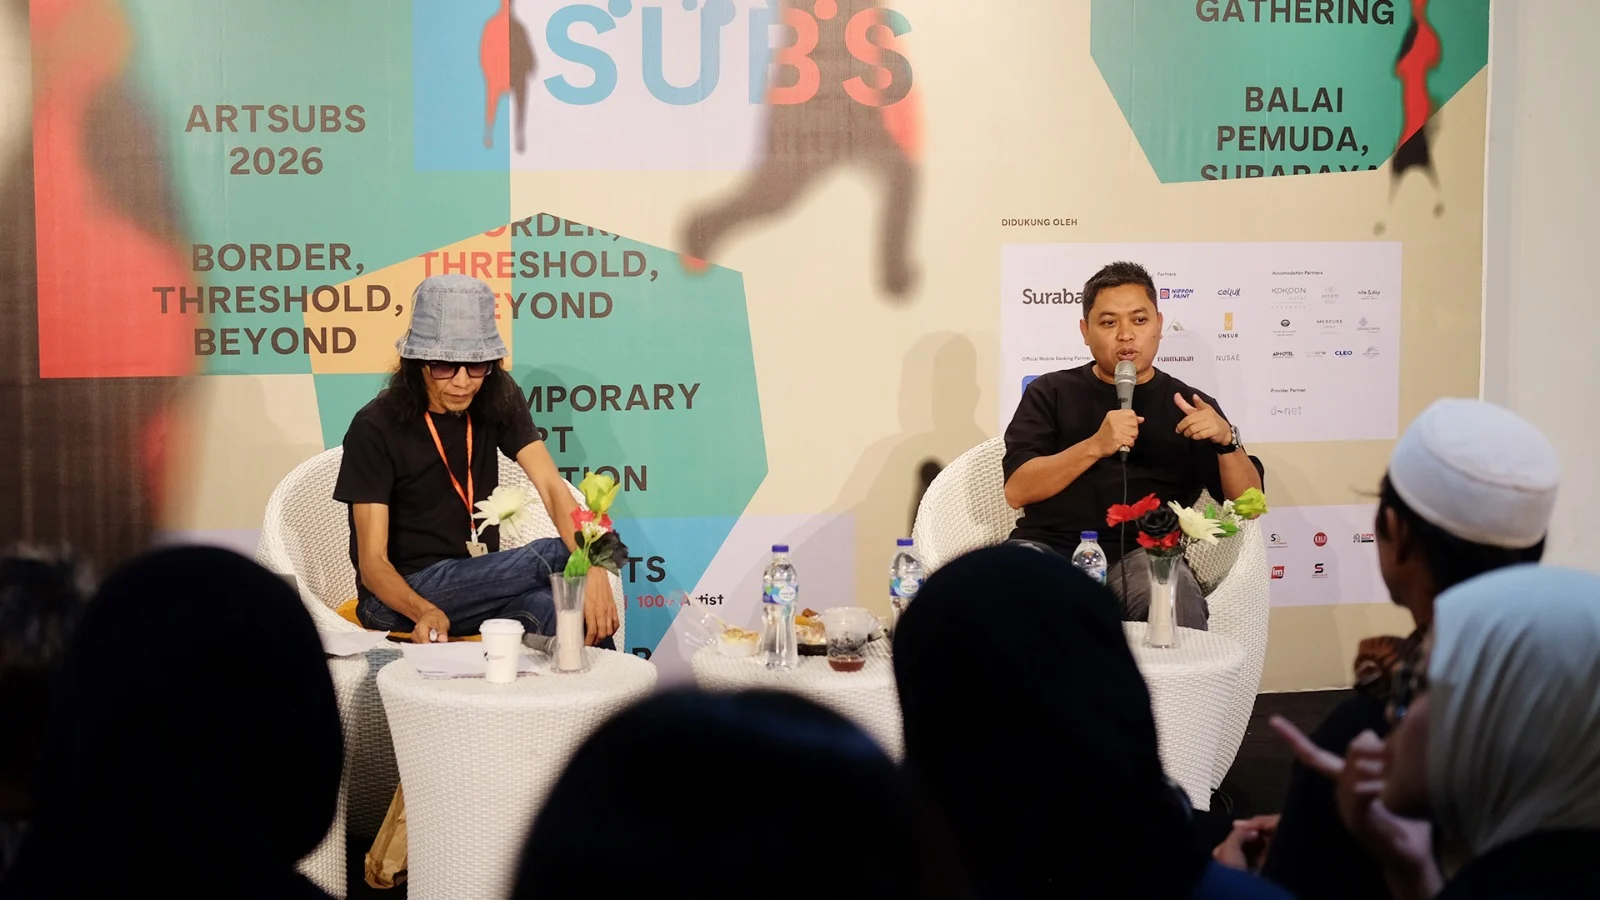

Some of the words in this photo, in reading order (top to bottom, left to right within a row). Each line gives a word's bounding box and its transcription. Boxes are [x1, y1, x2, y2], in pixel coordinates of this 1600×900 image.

[1196, 0, 1394, 25] GATHERING
[543, 4, 913, 107] SUBS
[1245, 86, 1343, 112] BALAI
[185, 104, 366, 133] ARTSUBS
[1217, 125, 1369, 156] PEMUDA,
[230, 147, 323, 175] 2026
[1001, 218, 1050, 227] DIDUKUNG
[1053, 218, 1078, 226] OLEH
[192, 243, 364, 276] BORDER,
[418, 250, 658, 282] THRESHOLD,
[152, 285, 404, 317] THRESHOLD,
[1022, 288, 1083, 305] Suraba
[1271, 287, 1307, 295] KOKOON
[194, 327, 357, 356] BEYOND
[518, 383, 701, 412] MPORARY
